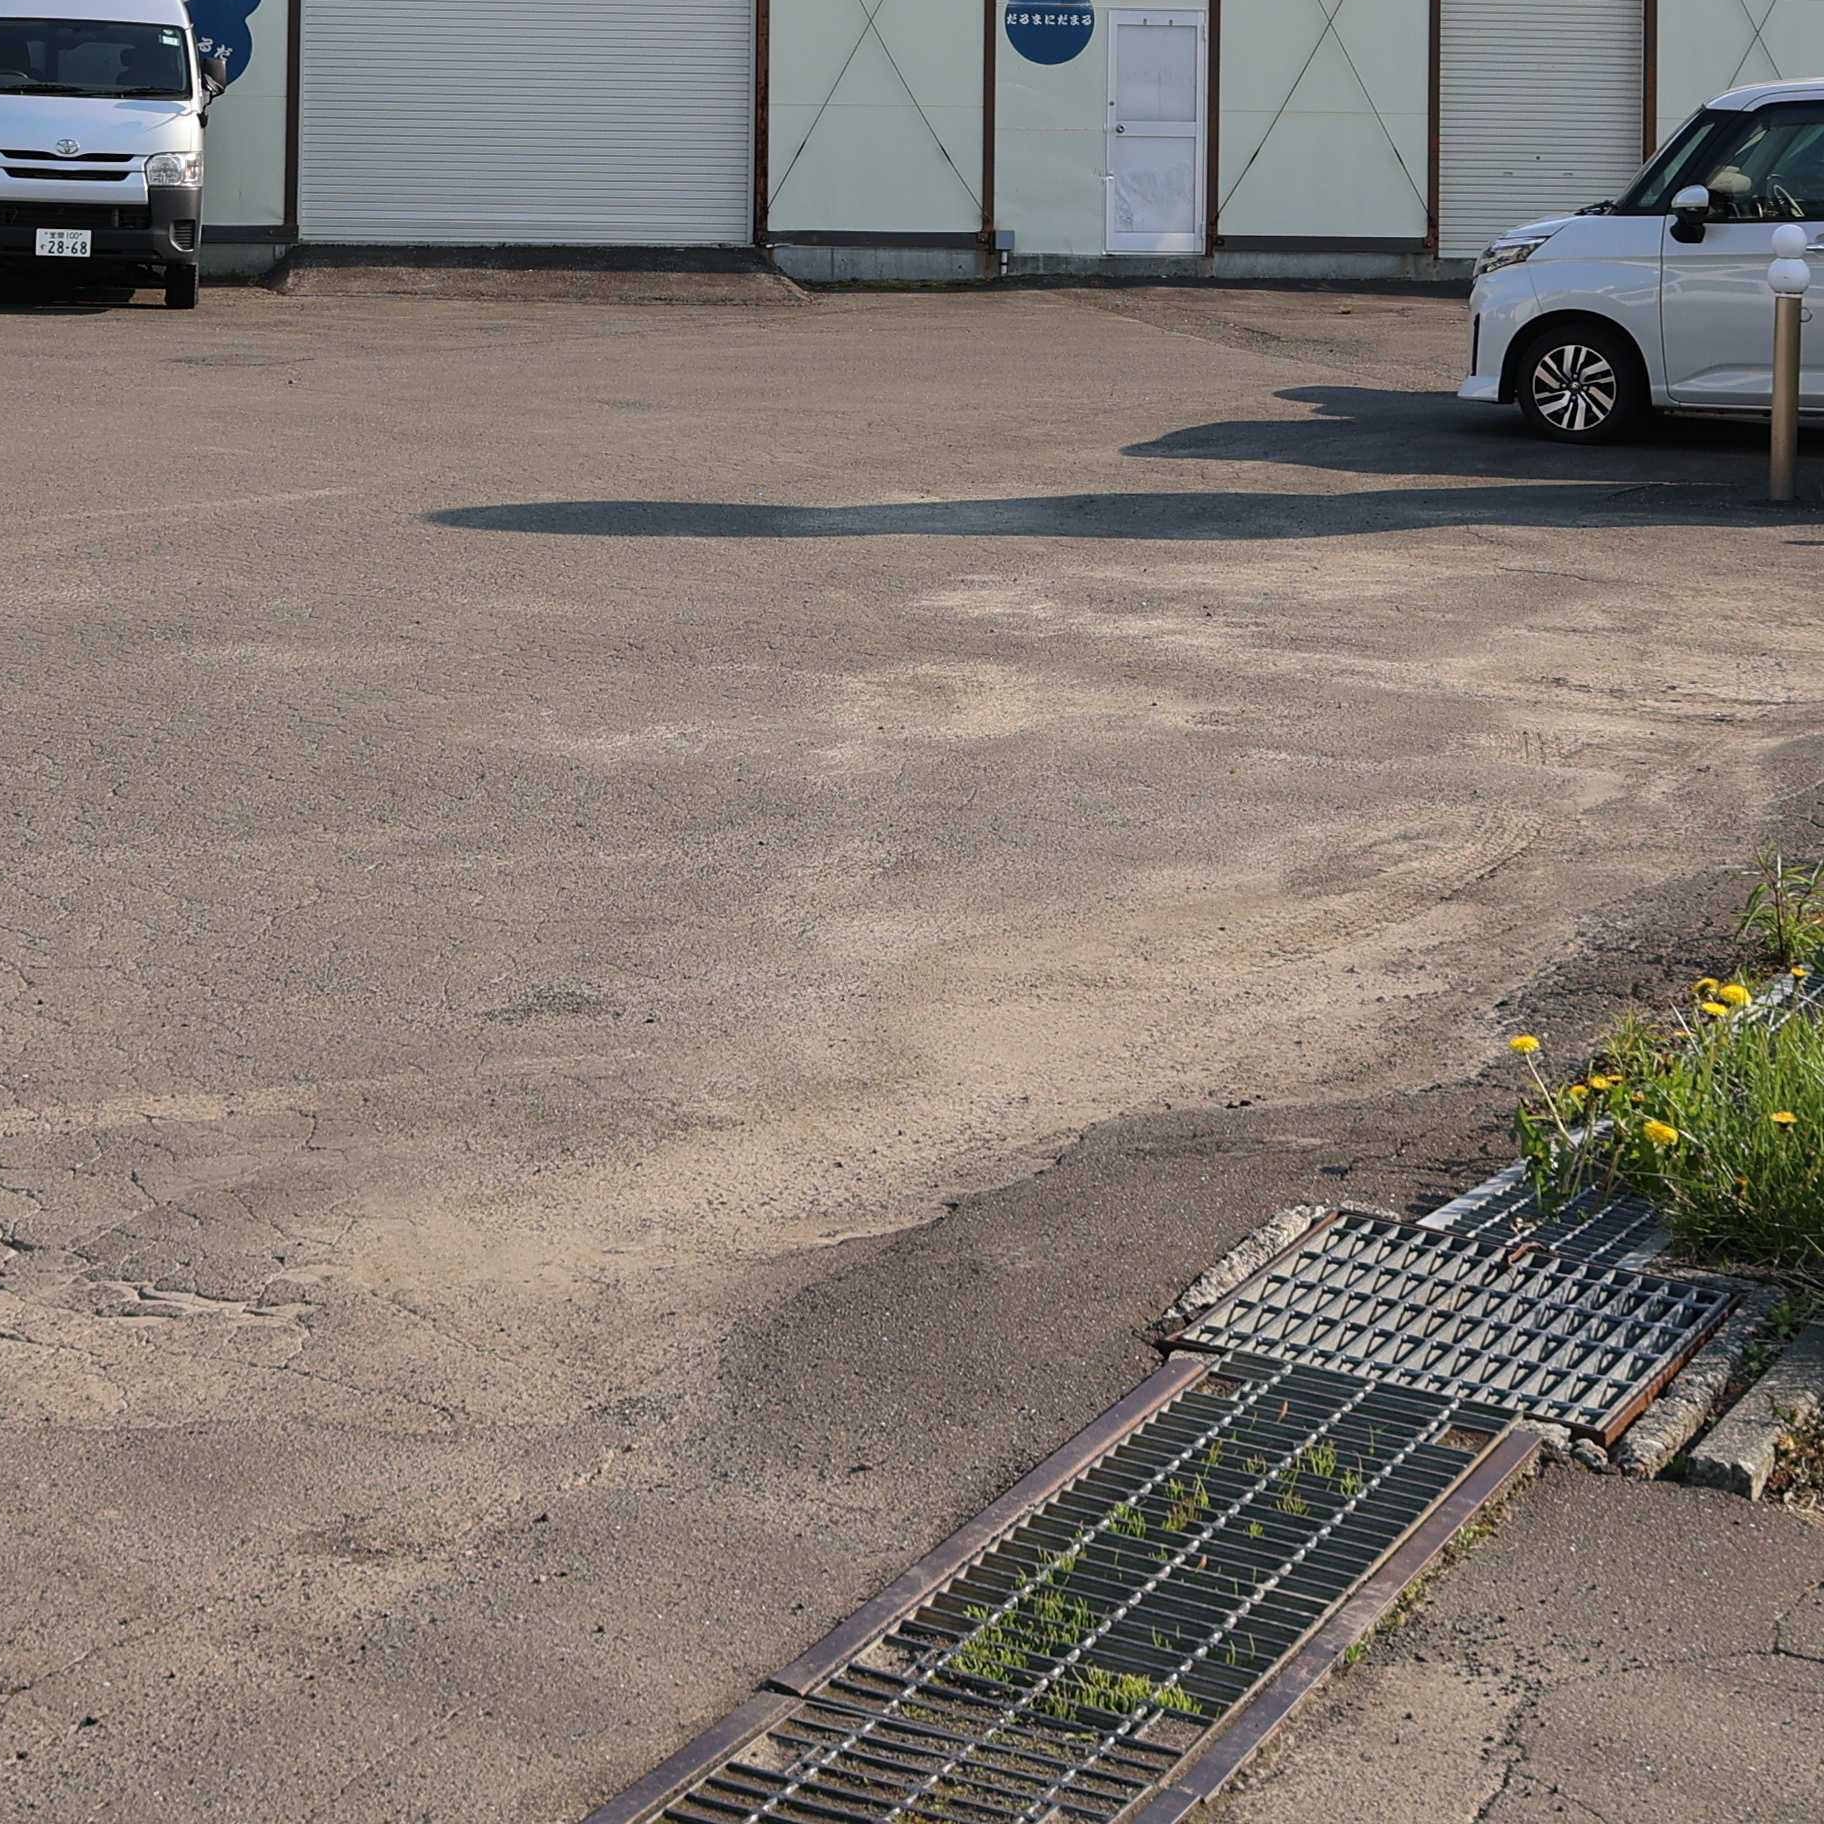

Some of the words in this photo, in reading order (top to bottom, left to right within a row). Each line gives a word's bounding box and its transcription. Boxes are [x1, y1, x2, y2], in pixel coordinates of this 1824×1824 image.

[1006, 13, 1092, 26] だるまにだまる
[47, 240, 88, 255] 28-68
